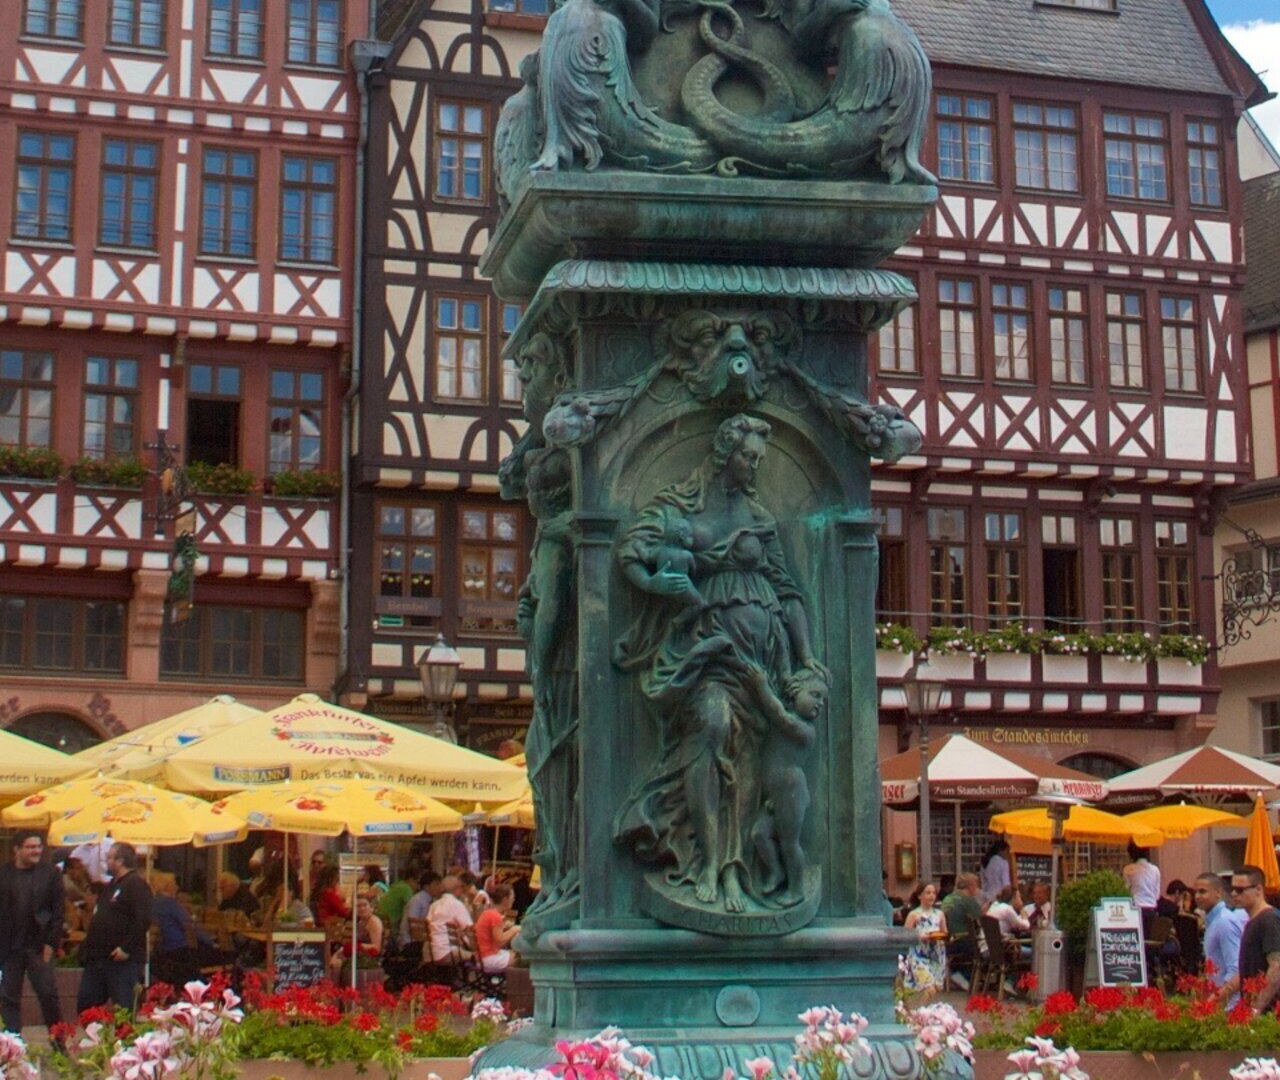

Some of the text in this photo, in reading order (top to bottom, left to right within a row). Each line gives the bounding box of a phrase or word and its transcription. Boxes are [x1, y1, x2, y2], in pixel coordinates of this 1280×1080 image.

[324, 768, 352, 780] Beste
[399, 773, 426, 787] Apfel
[430, 776, 469, 790] werden
[679, 909, 795, 934] CHARITAS
